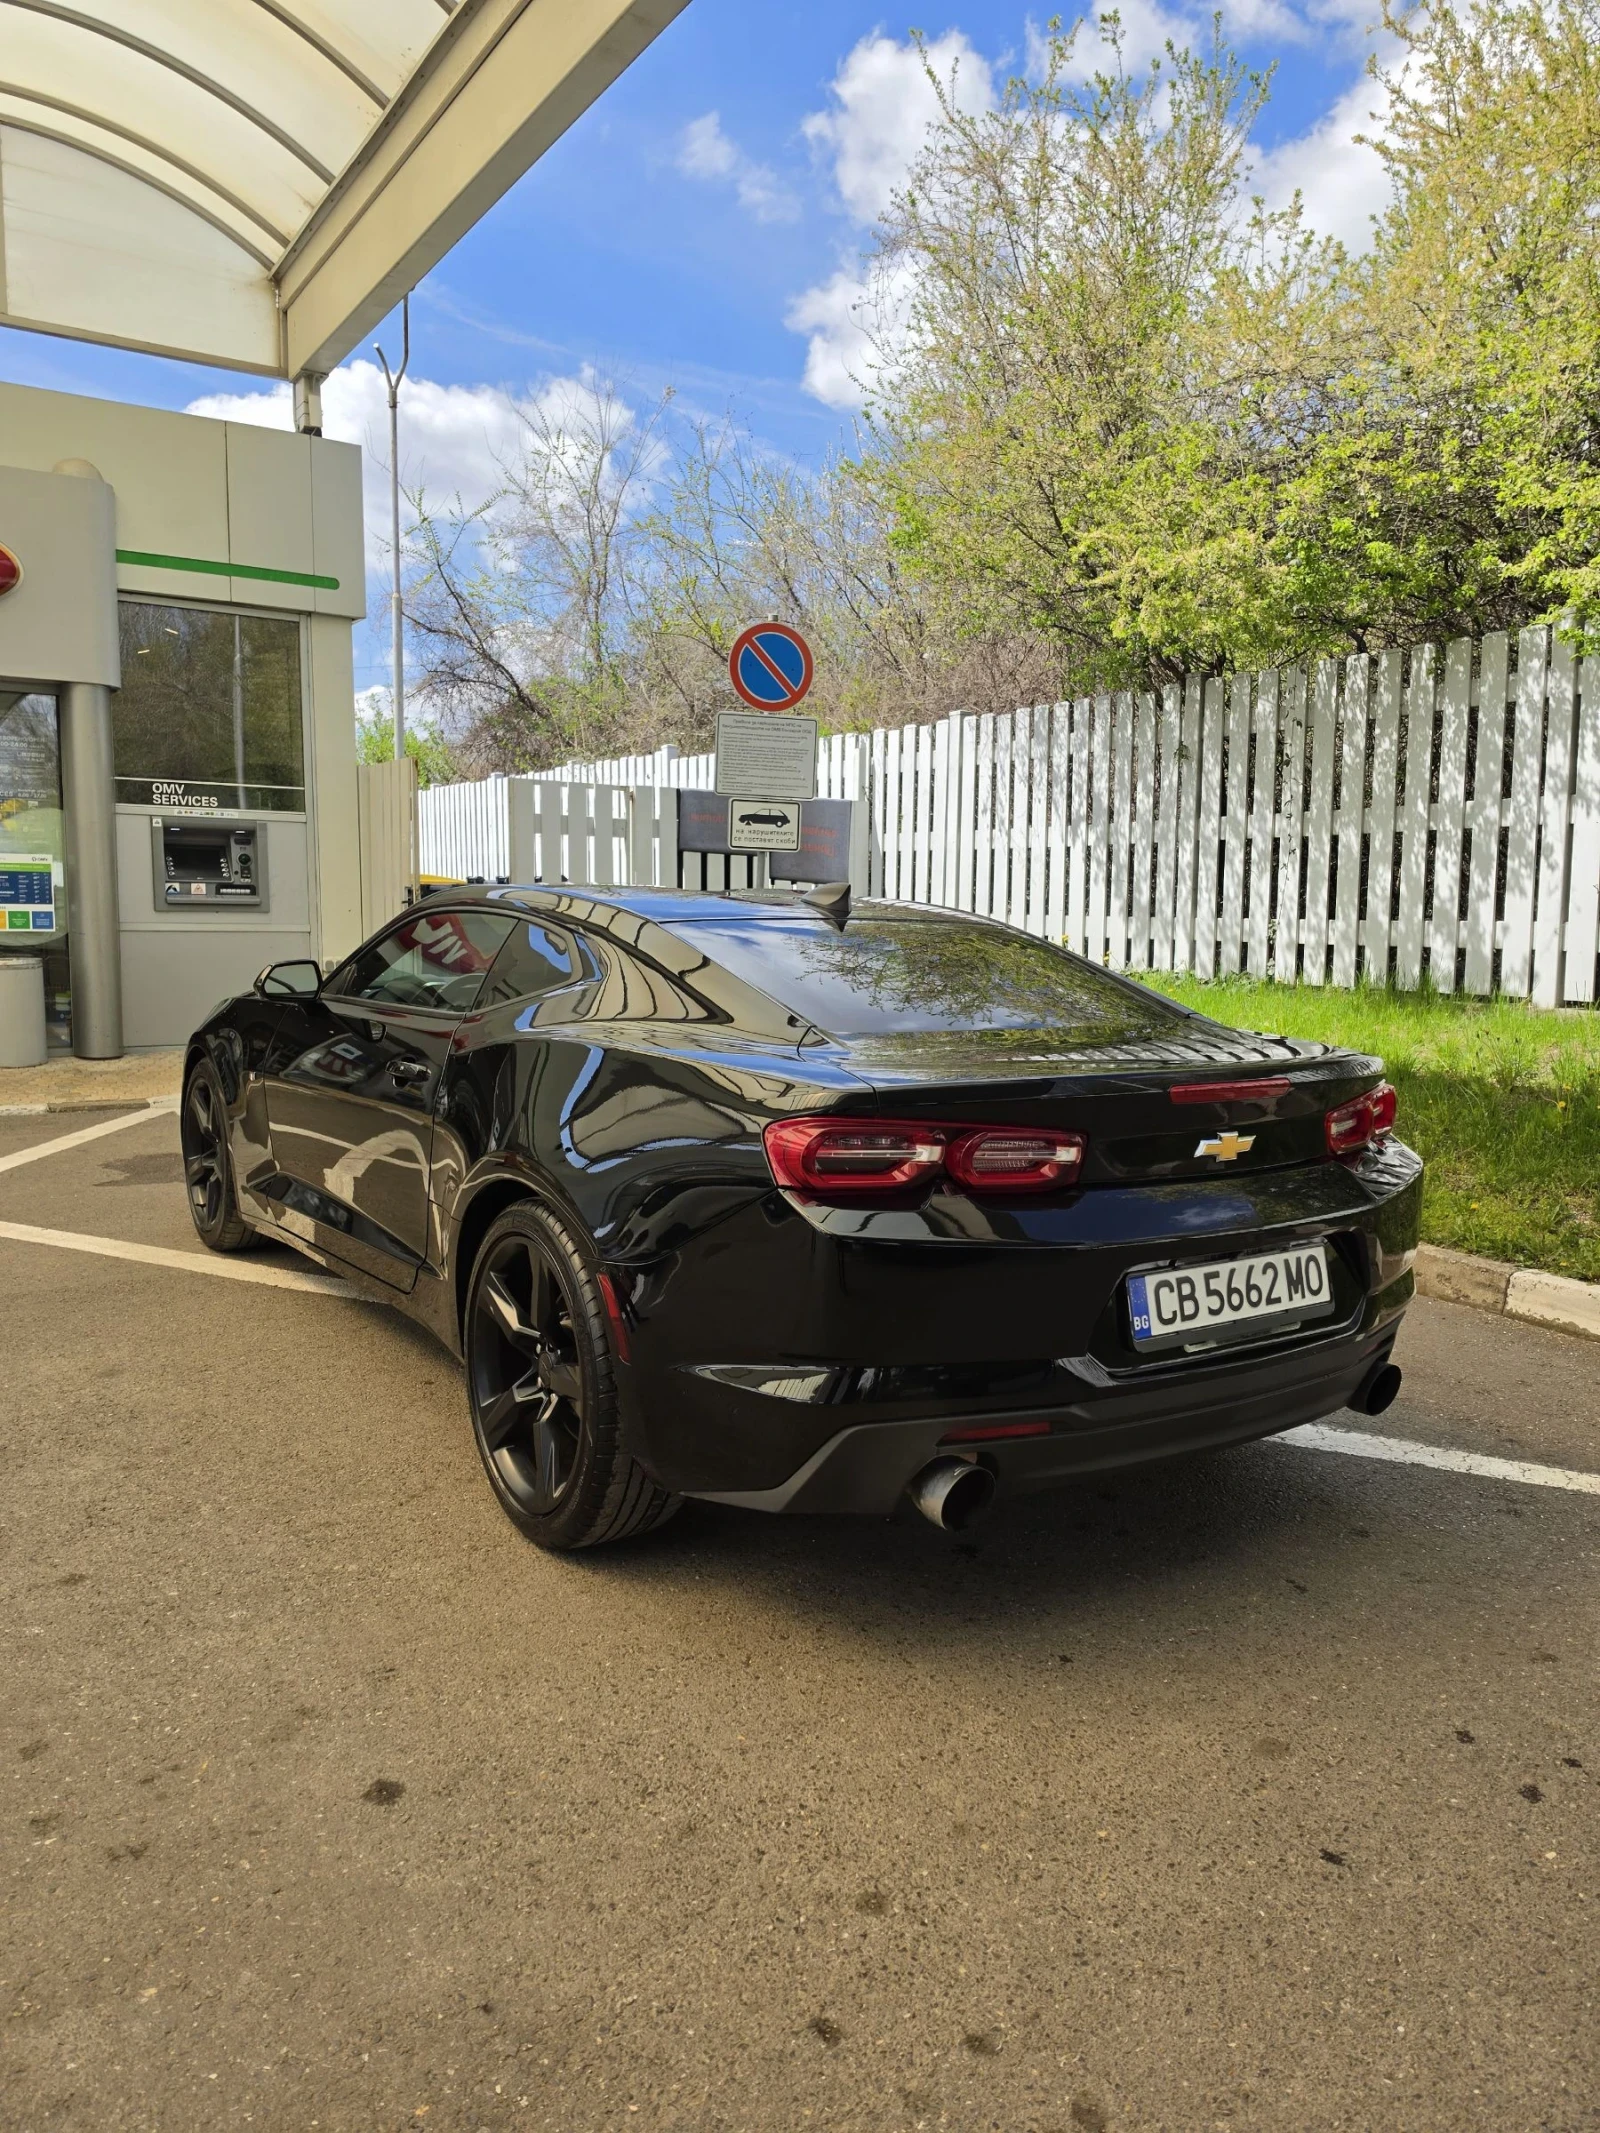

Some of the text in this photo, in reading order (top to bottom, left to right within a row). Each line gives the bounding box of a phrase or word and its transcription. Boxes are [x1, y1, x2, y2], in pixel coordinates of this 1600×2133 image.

[152, 783, 185, 794] OMV
[152, 794, 219, 807] SERVICES
[1133, 1315, 1149, 1331] BG
